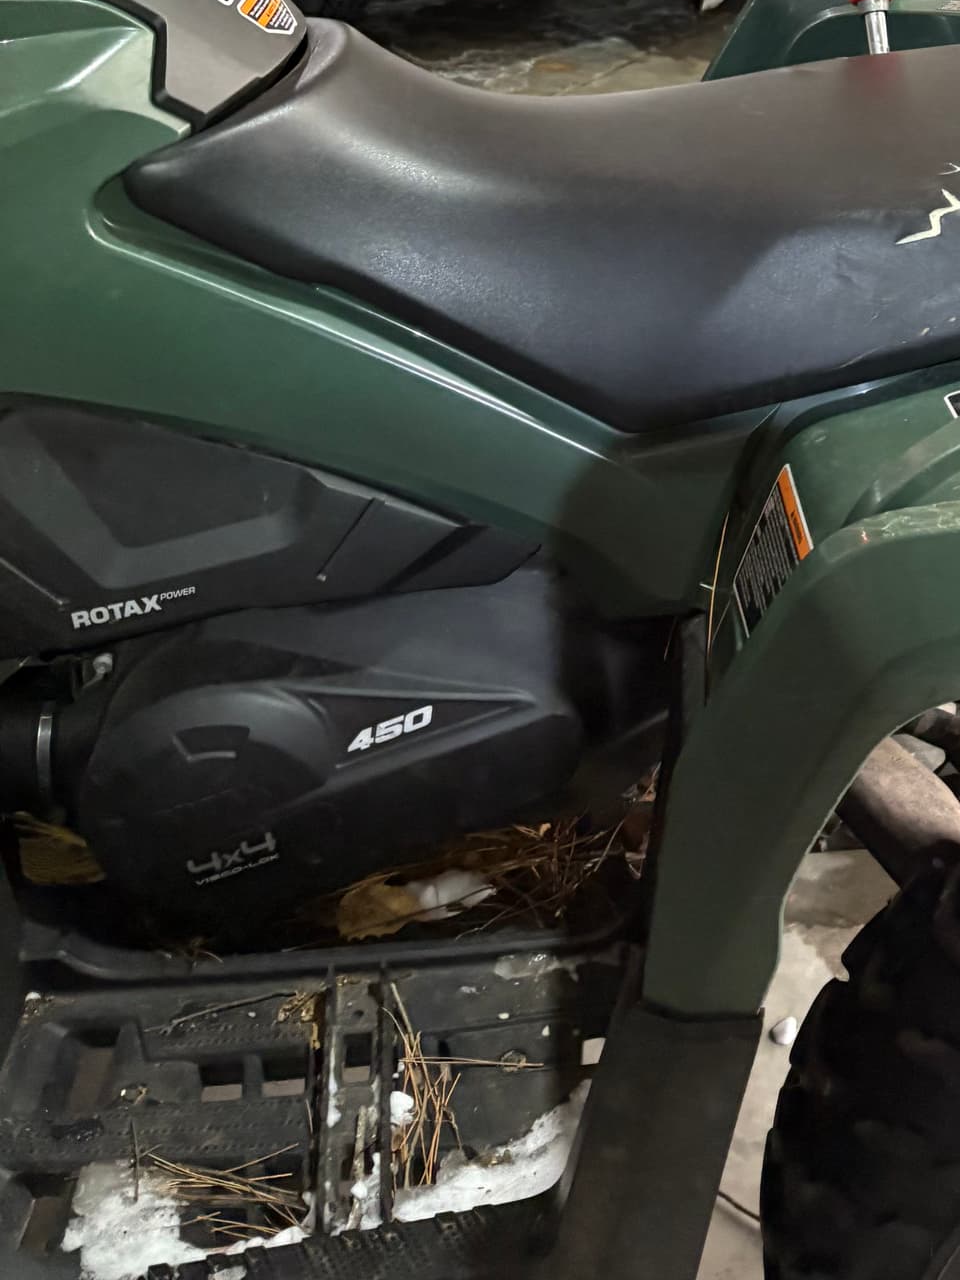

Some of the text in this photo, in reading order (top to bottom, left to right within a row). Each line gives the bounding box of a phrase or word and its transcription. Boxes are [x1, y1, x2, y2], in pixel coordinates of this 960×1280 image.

[70, 586, 196, 629] ROTAX POWER
[347, 704, 433, 753] 450
